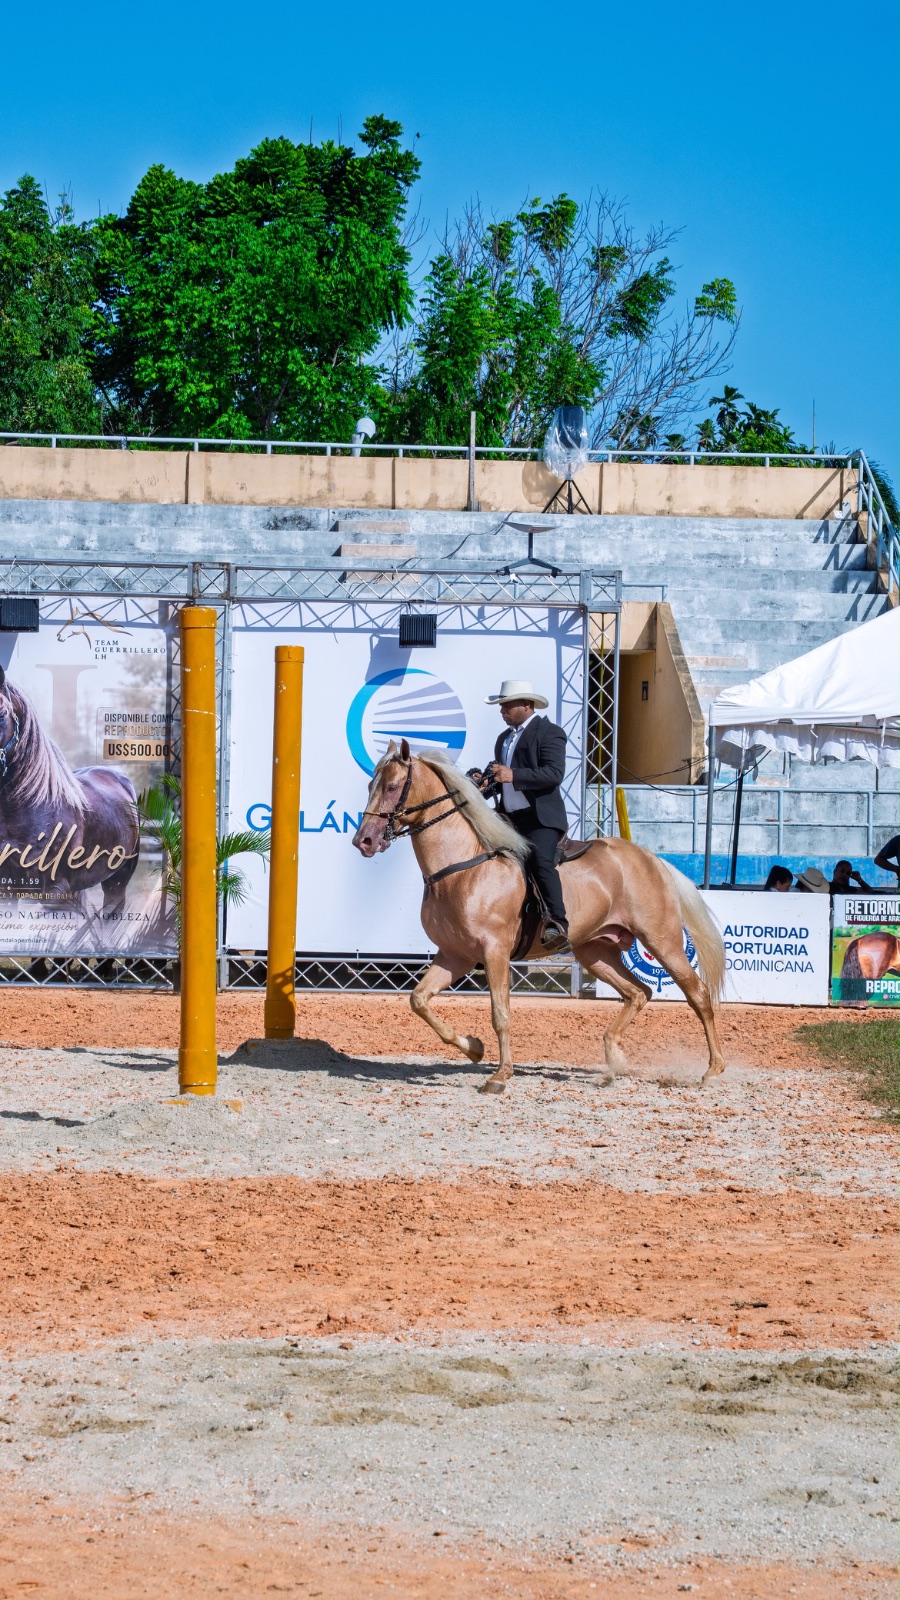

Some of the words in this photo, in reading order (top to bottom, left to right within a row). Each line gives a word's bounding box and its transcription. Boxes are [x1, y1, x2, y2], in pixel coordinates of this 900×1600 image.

[104, 713, 149, 723] DISPONIBLE
[108, 742, 170, 757] US$500.00
[246, 799, 363, 833] GLÁN
[21, 877, 40, 885] 1.59
[45, 892, 54, 900] DE
[18, 911, 75, 920] NATURAL
[94, 912, 150, 921] NOBLEZA
[0, 921, 24, 930] ima
[723, 925, 809, 939] AUTORIDAD
[724, 942, 808, 956] PORTUARIA
[725, 958, 814, 973] DOMINICANA
